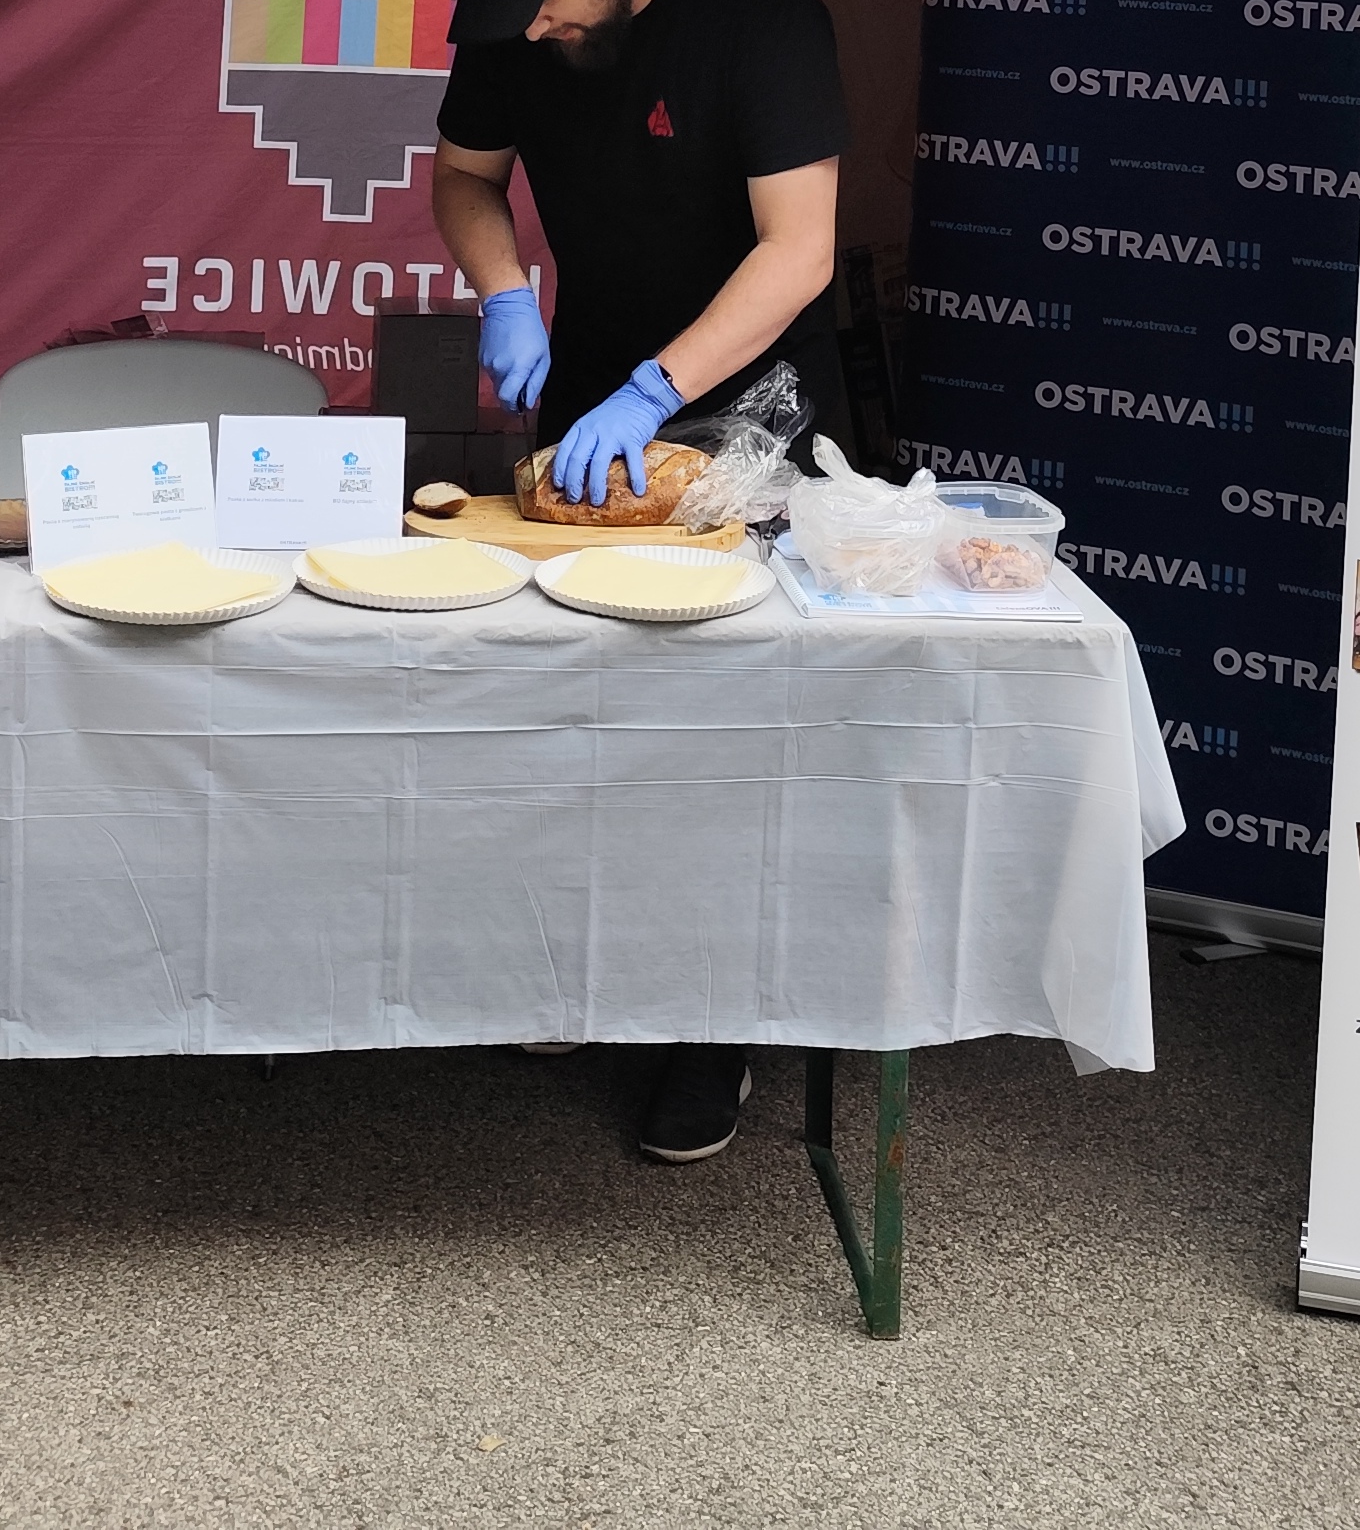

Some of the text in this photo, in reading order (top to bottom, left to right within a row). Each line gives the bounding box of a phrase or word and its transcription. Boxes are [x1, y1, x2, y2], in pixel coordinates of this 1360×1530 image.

[915, 133, 1079, 173] STRAVA!!!
[905, 285, 1072, 331] STRAVA!!!
[1228, 322, 1356, 364] OSTRA
[893, 438, 1065, 490] STRAVA!!!
[1221, 484, 1348, 530] OSTRA
[1058, 542, 1247, 596] STRAVA!!!
[1212, 647, 1339, 693] OSTRA
[1204, 808, 1331, 857] OSTRA
